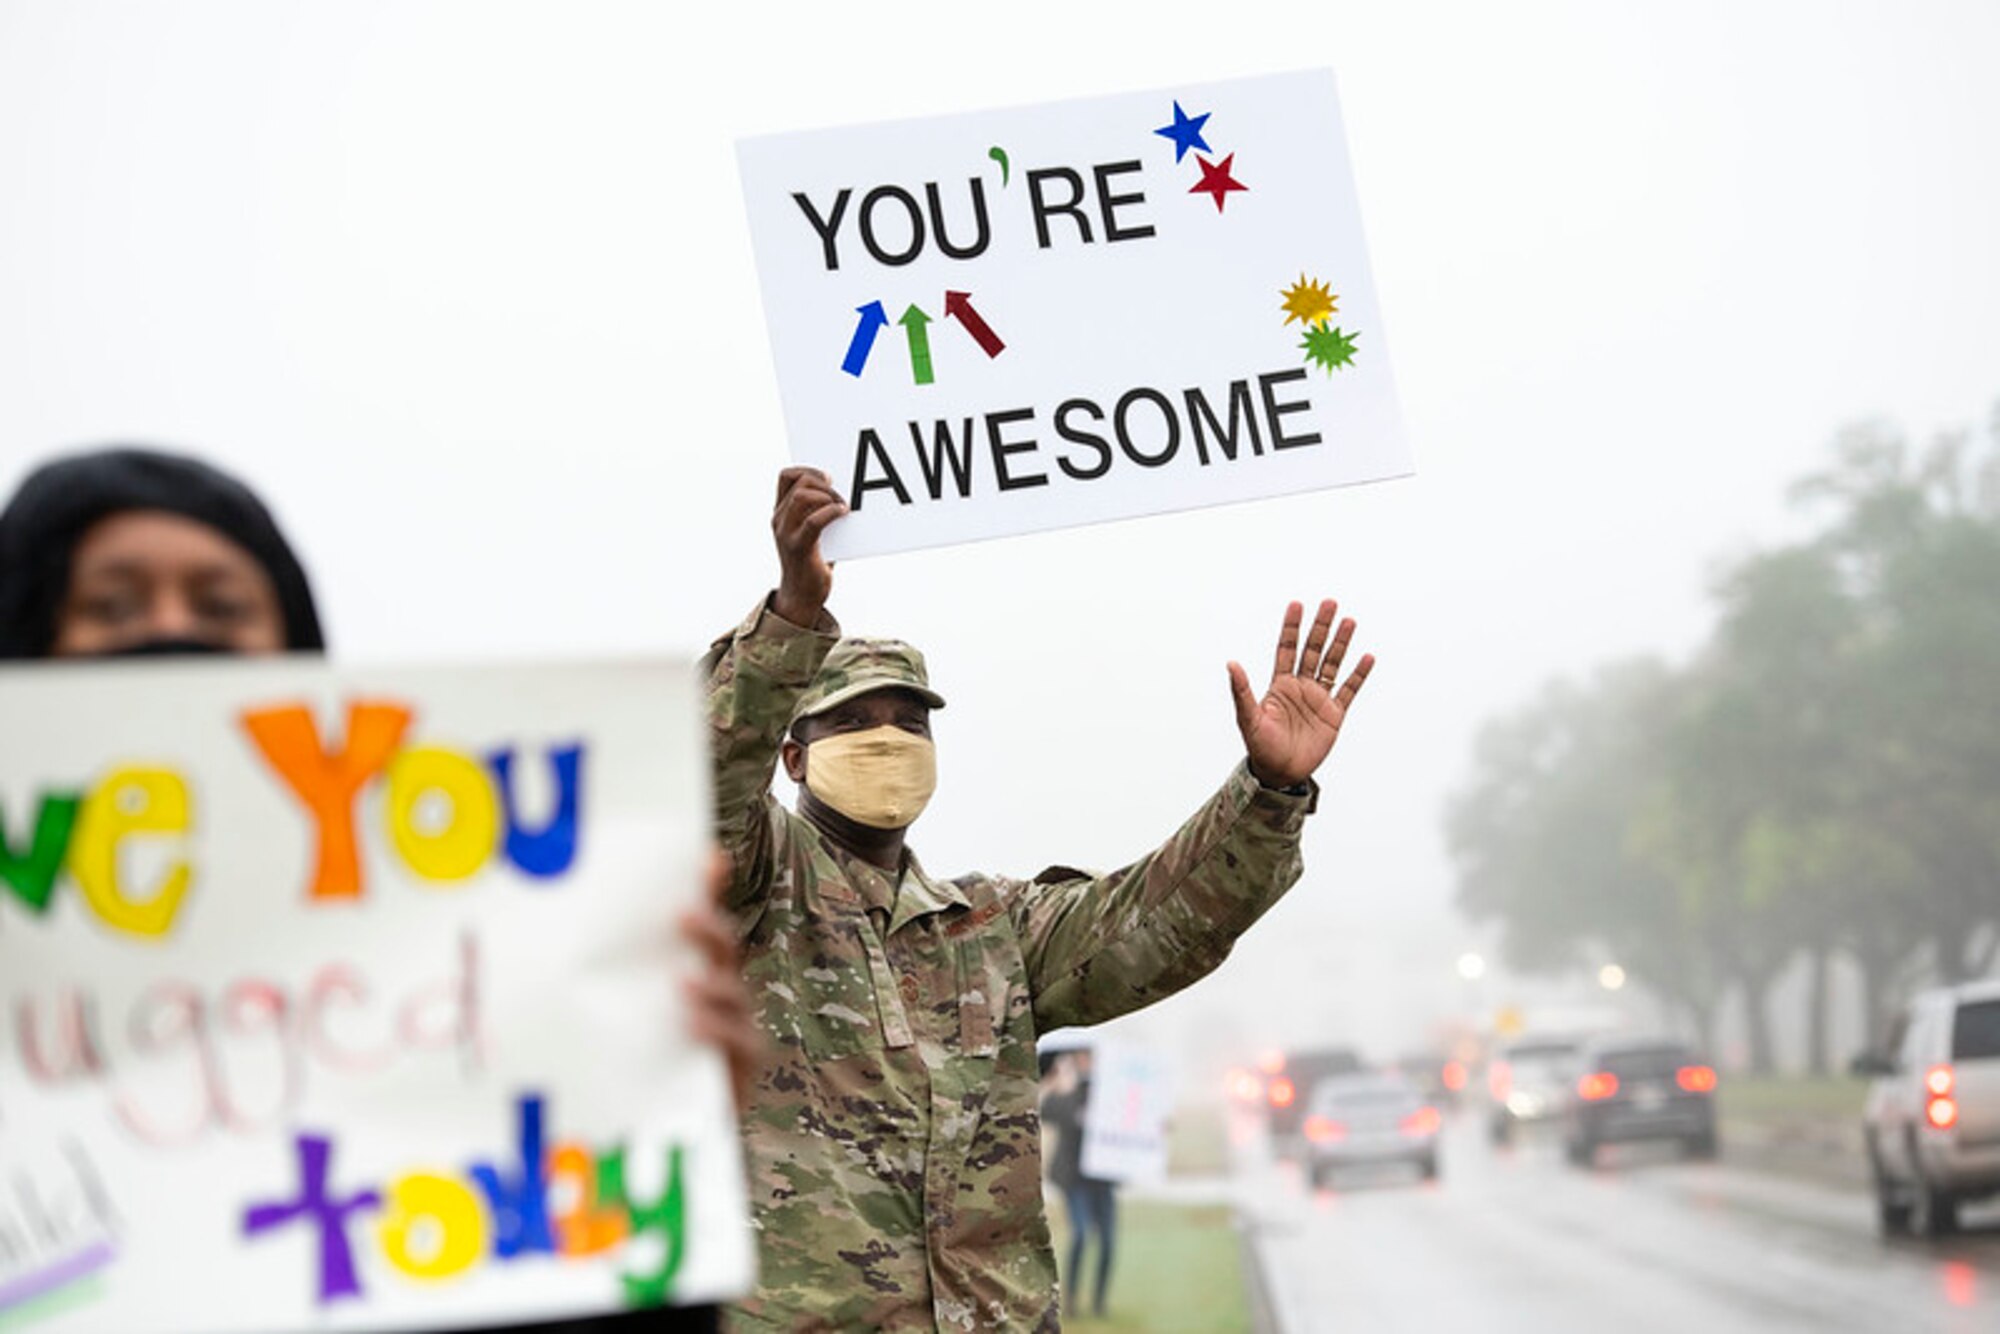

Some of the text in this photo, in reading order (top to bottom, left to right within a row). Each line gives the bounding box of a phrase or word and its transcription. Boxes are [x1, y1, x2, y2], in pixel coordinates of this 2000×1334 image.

[790, 146, 1157, 271] YOU'RE
[848, 367, 1323, 512] AWESOME
[241, 1092, 688, 1309] today
